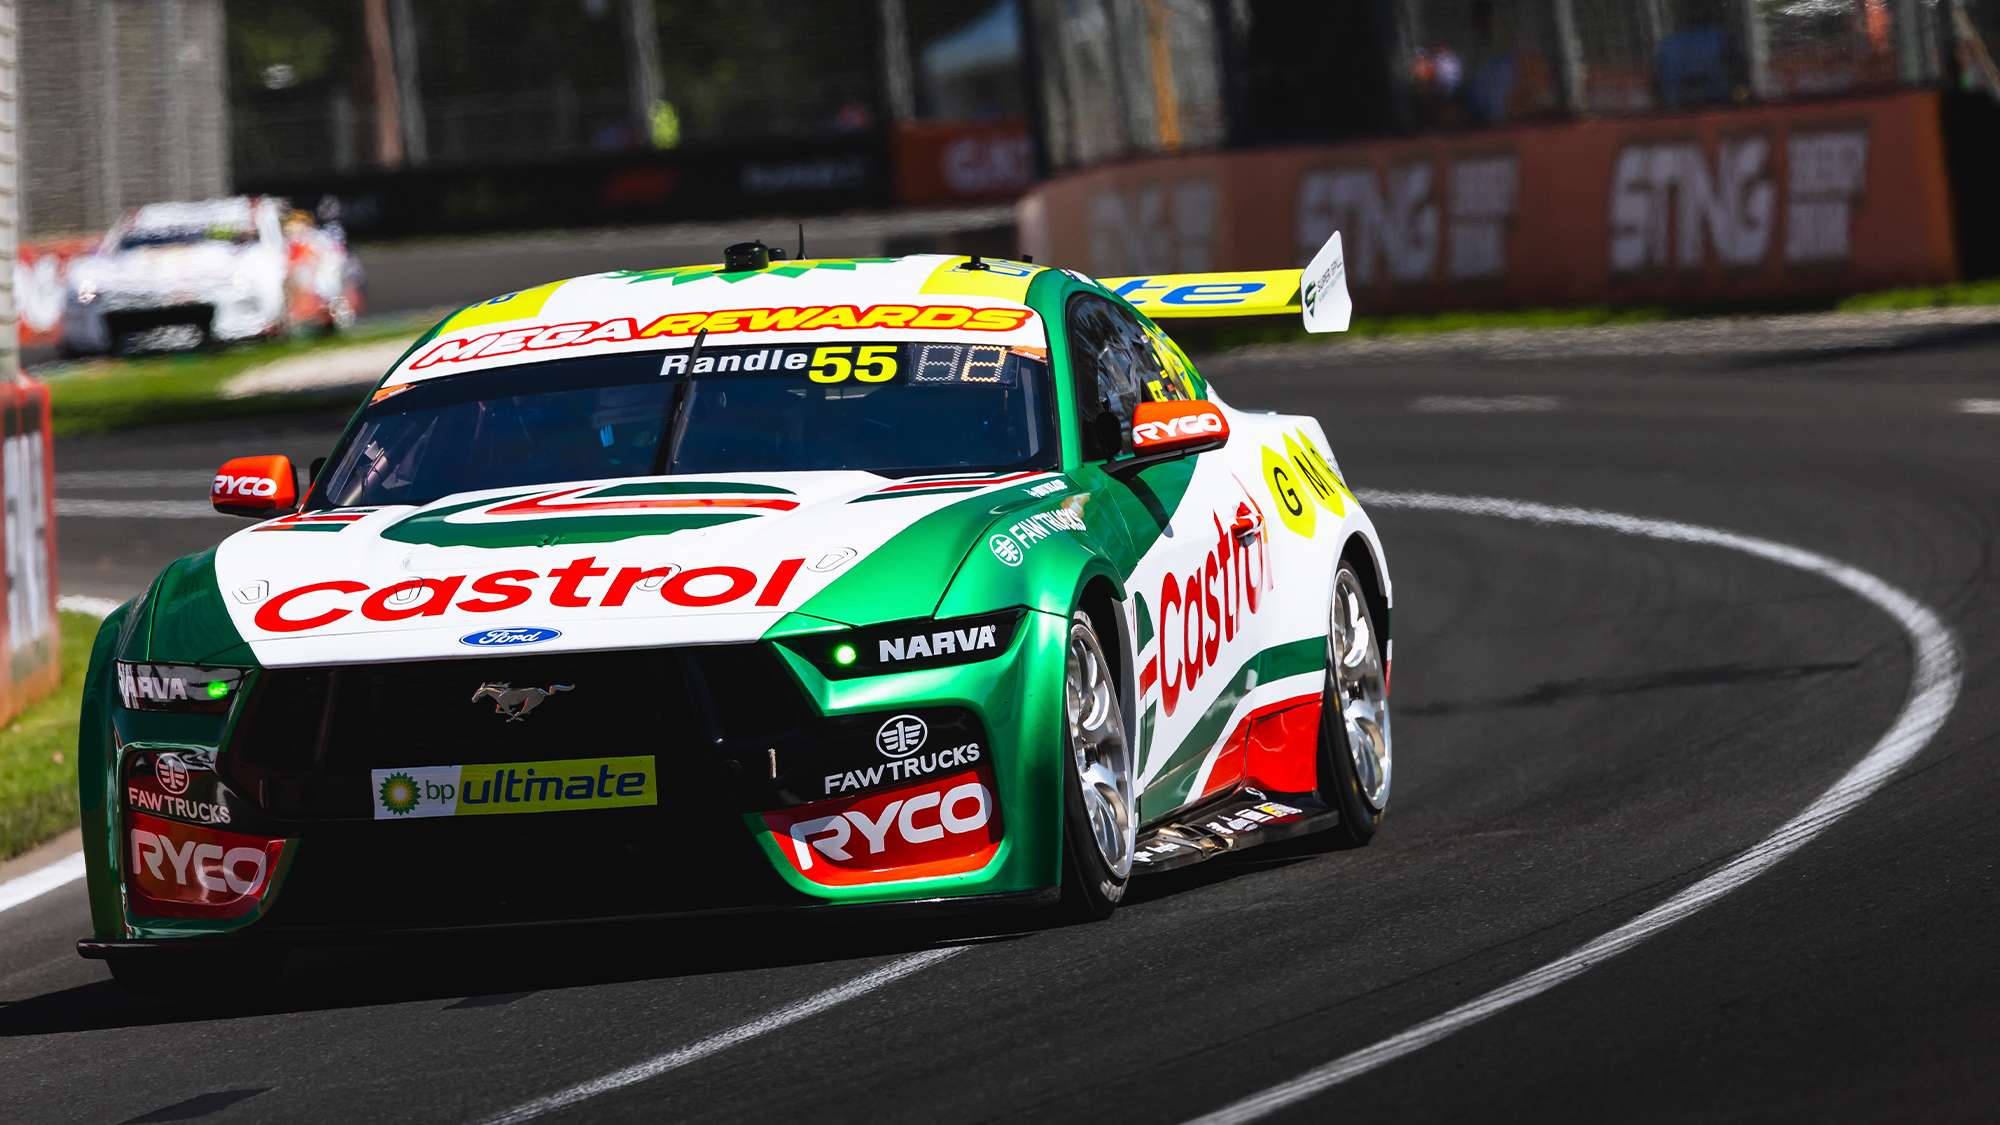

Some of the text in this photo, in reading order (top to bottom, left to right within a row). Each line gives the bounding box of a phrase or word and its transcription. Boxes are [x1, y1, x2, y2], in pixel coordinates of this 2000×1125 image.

[409, 304, 1034, 371] MEGA REWARDS
[659, 345, 898, 384] Randle 55
[1132, 413, 1222, 444] RYCO
[213, 475, 277, 496] RYCO
[253, 555, 806, 632] Castrol
[479, 628, 543, 644] Ford
[426, 764, 646, 805] bp ultimate
[790, 782, 992, 870] RYCO
[130, 828, 267, 895] RYCO
